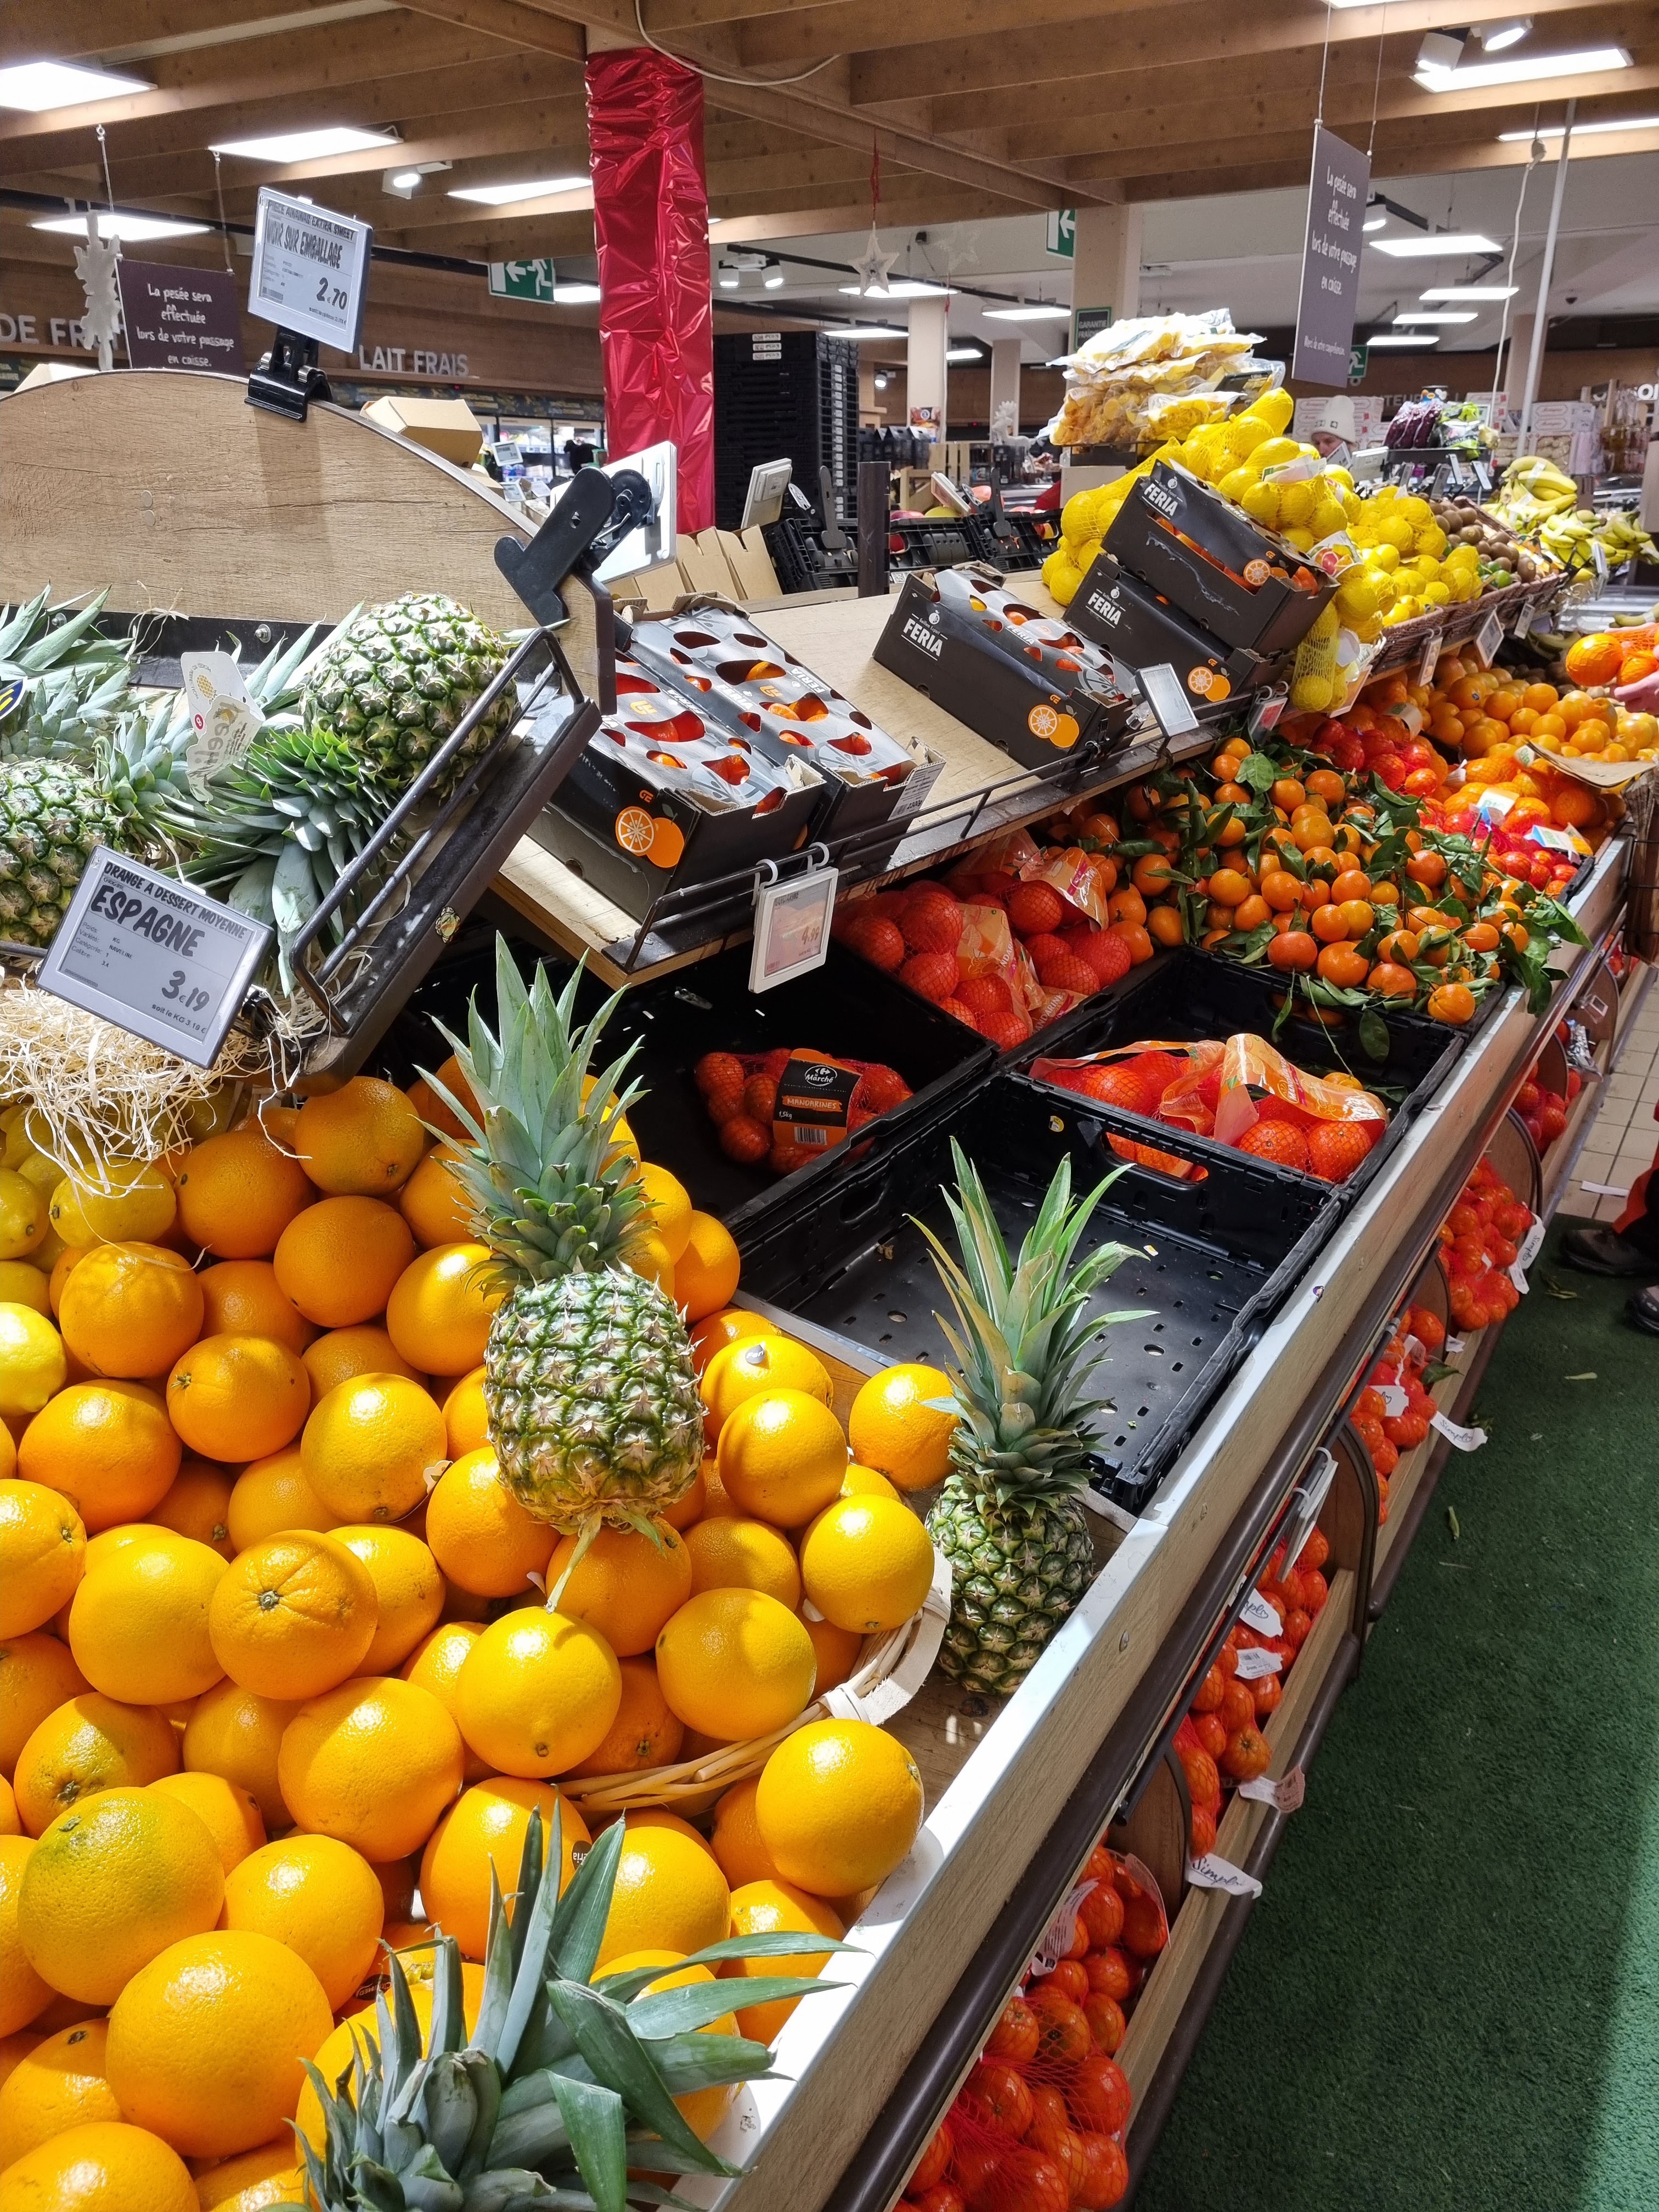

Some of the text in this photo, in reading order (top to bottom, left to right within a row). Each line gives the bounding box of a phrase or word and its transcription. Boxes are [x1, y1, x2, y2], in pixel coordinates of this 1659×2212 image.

[146, 283, 212, 302] La pesée sera
[161, 303, 206, 324] effectuée
[136, 326, 234, 352] lors de votre passage
[167, 354, 212, 367] en caisse.
[359, 345, 470, 376] LAIT FRAIS
[1144, 483, 1178, 516] FERIA
[1087, 592, 1121, 625] FERIA
[903, 618, 943, 657] FERIA
[1007, 625, 1035, 645] FERIA
[791, 667, 826, 693] FERIA
[715, 684, 755, 710] FERIA
[103, 862, 248, 939] ORANGE A DESSERT MOYENNE
[90, 884, 205, 957] ESPAGNE
[151, 1003, 166, 1015] soit
[166, 1009, 173, 1019] le
[173, 1013, 185, 1024] KG
[805, 1074, 834, 1084] Marché
[778, 1111, 793, 1120] 1,5kg
[787, 1098, 837, 1110] MANDARINES
